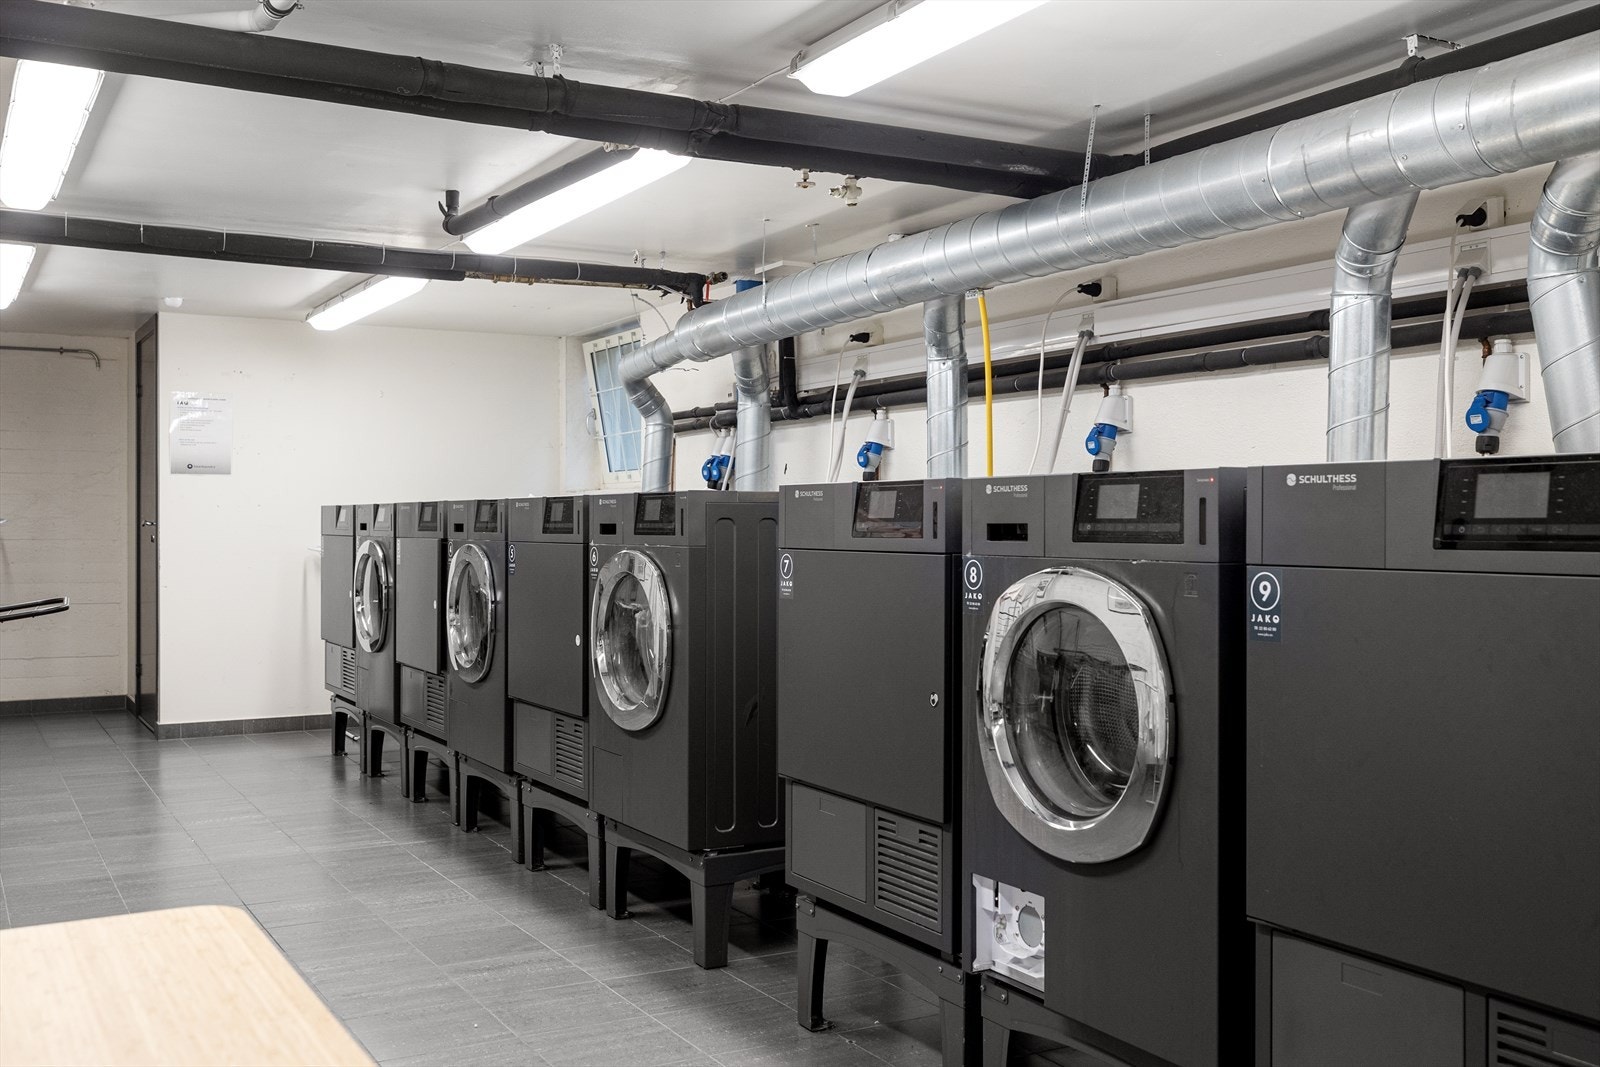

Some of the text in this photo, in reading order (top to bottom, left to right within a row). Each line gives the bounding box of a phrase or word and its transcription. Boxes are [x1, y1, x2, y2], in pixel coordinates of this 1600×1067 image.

[1298, 474, 1357, 484] SCHULTHESS
[993, 485, 1028, 493] SCHULTHESS
[510, 548, 514, 559] 5
[592, 551, 597, 562] 6
[783, 559, 790, 573] 7
[970, 566, 977, 583] 8
[964, 592, 983, 600] JAKO
[1258, 580, 1272, 602] 9
[1250, 613, 1280, 624] JAKO
